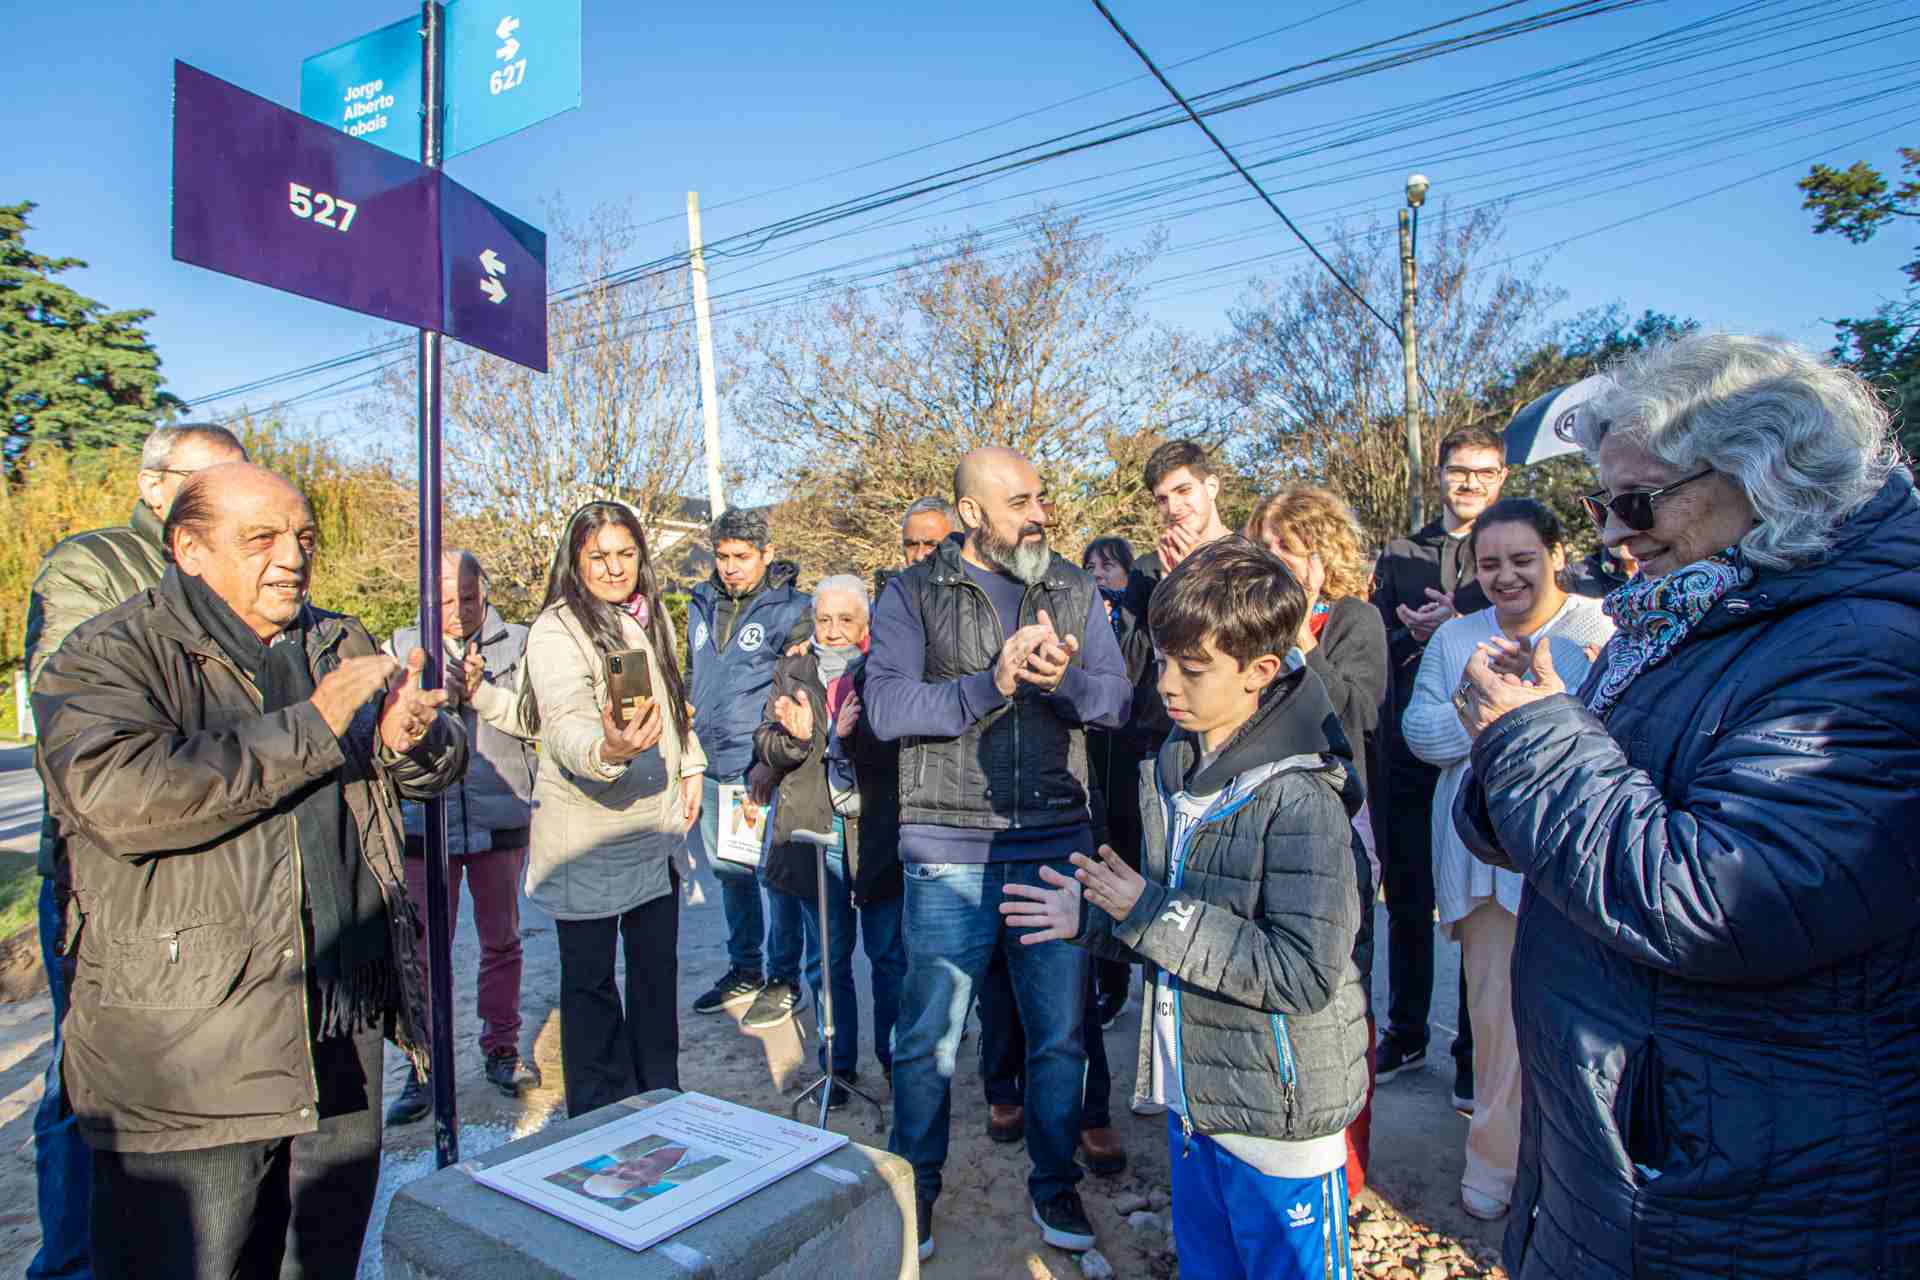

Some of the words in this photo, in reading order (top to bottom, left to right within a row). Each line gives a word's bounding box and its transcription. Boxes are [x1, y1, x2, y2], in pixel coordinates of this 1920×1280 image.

[344, 79, 384, 101] Jorge
[490, 58, 527, 96] 627
[344, 95, 394, 120] Alberto
[289, 182, 357, 232] 527
